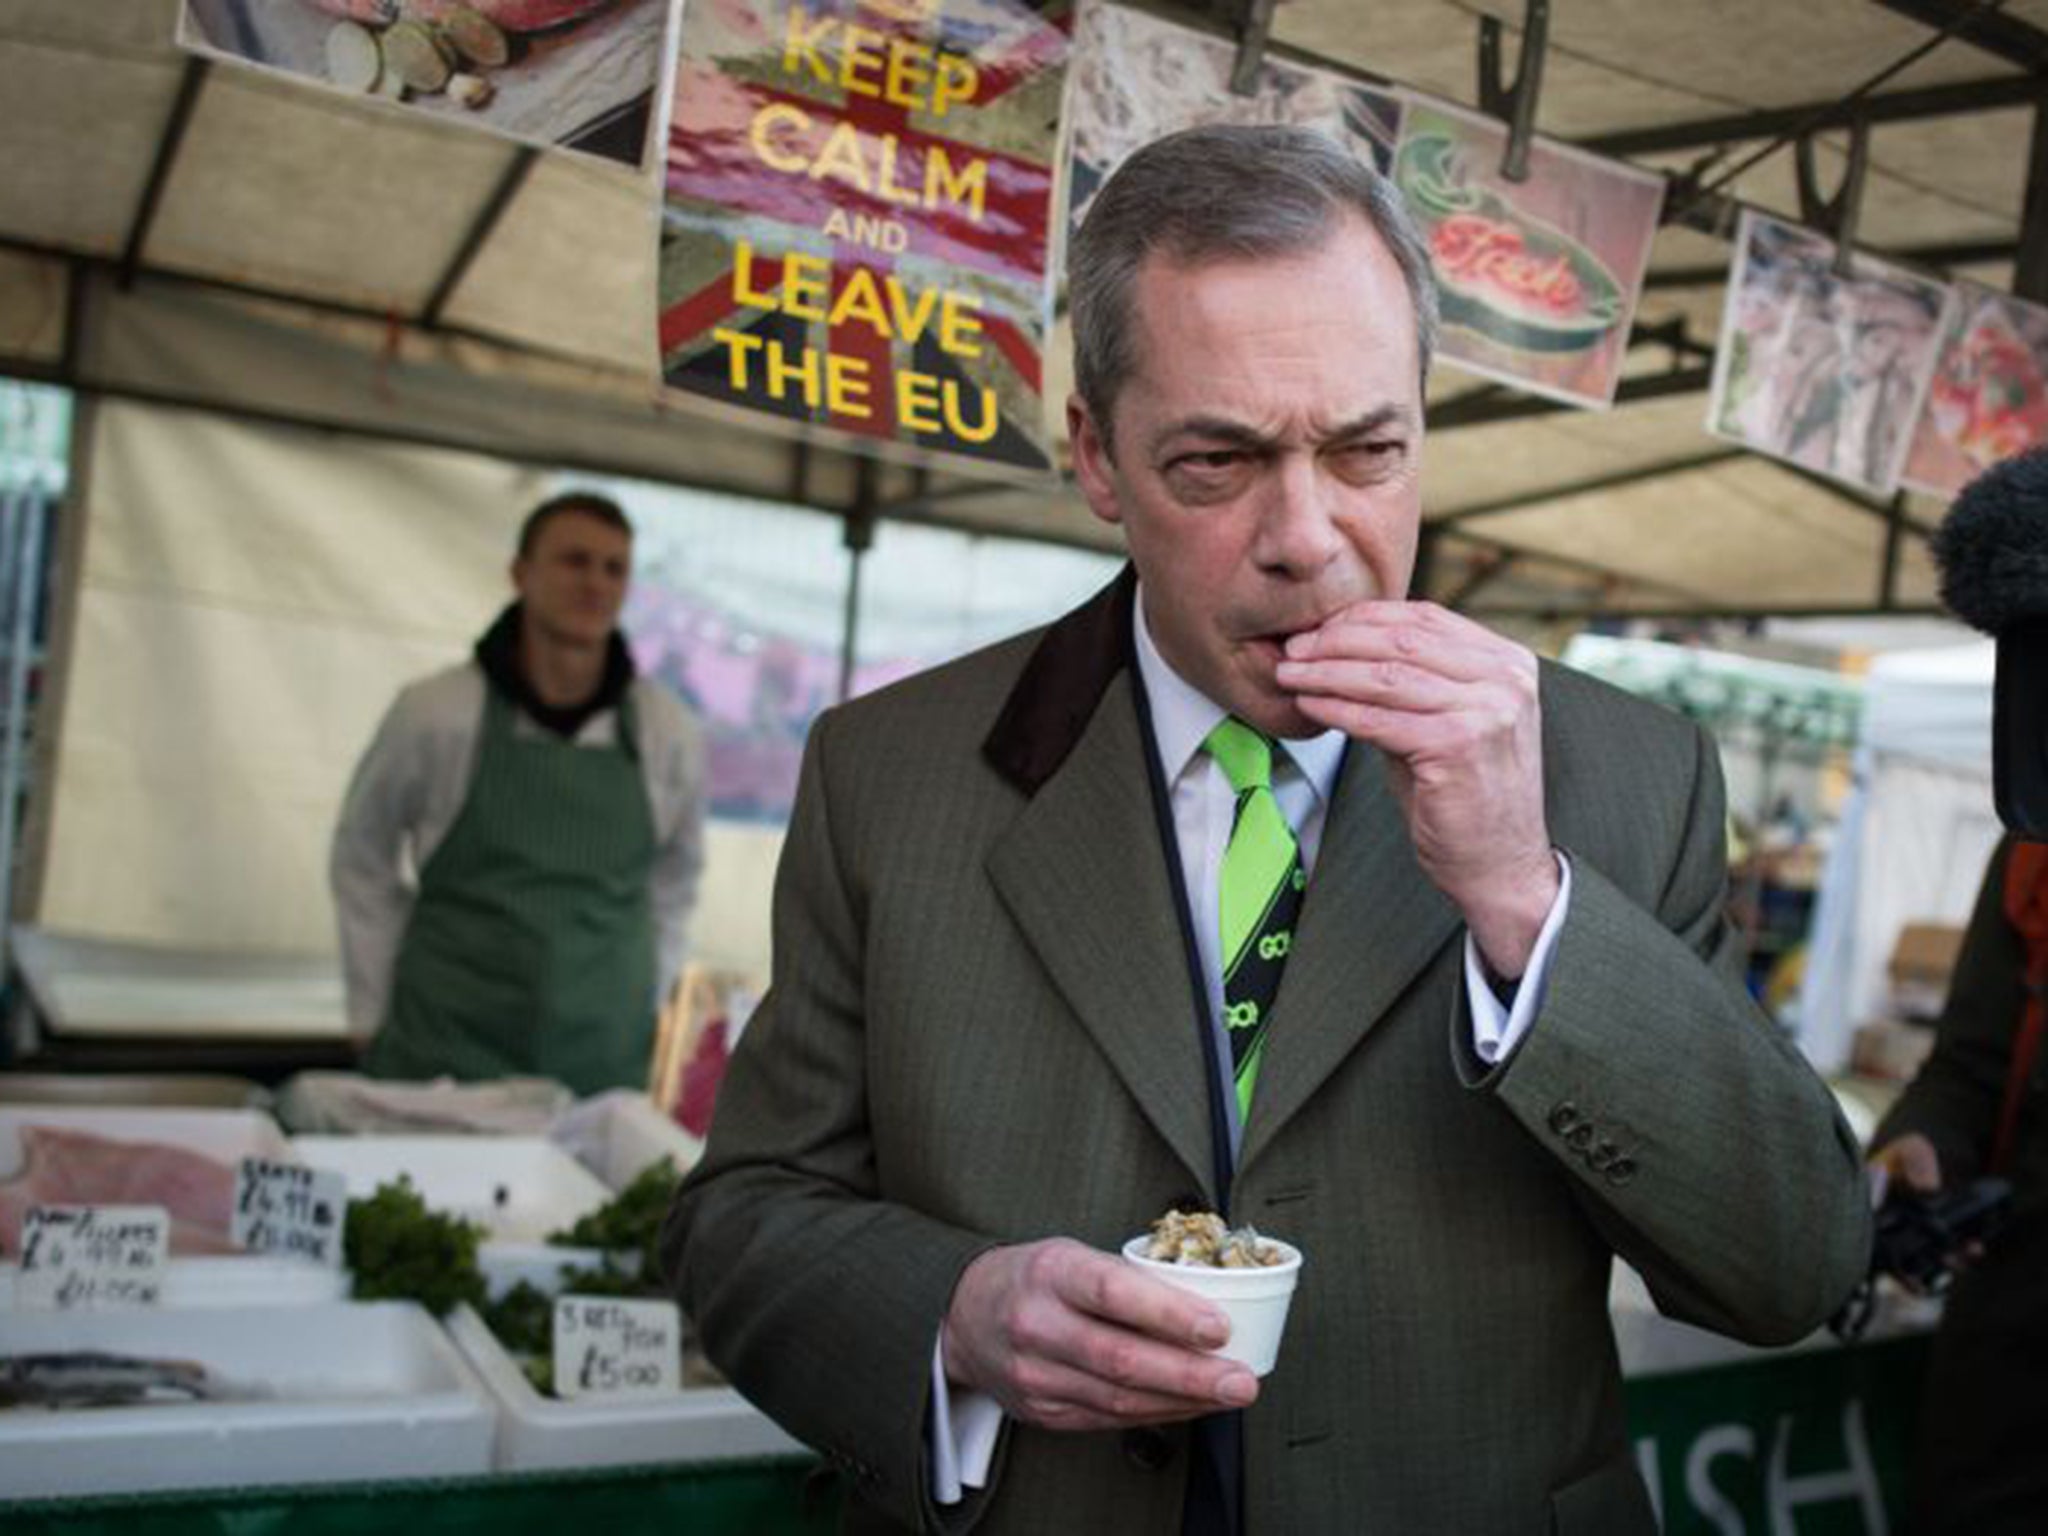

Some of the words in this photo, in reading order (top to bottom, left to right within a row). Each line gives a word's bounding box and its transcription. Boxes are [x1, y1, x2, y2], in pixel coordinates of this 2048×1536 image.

[783, 9, 979, 117] KEEP
[751, 103, 987, 222] CALM
[823, 208, 908, 254] AND
[733, 240, 984, 358] LEAVE
[713, 327, 872, 418] THE
[897, 369, 998, 443] EU
